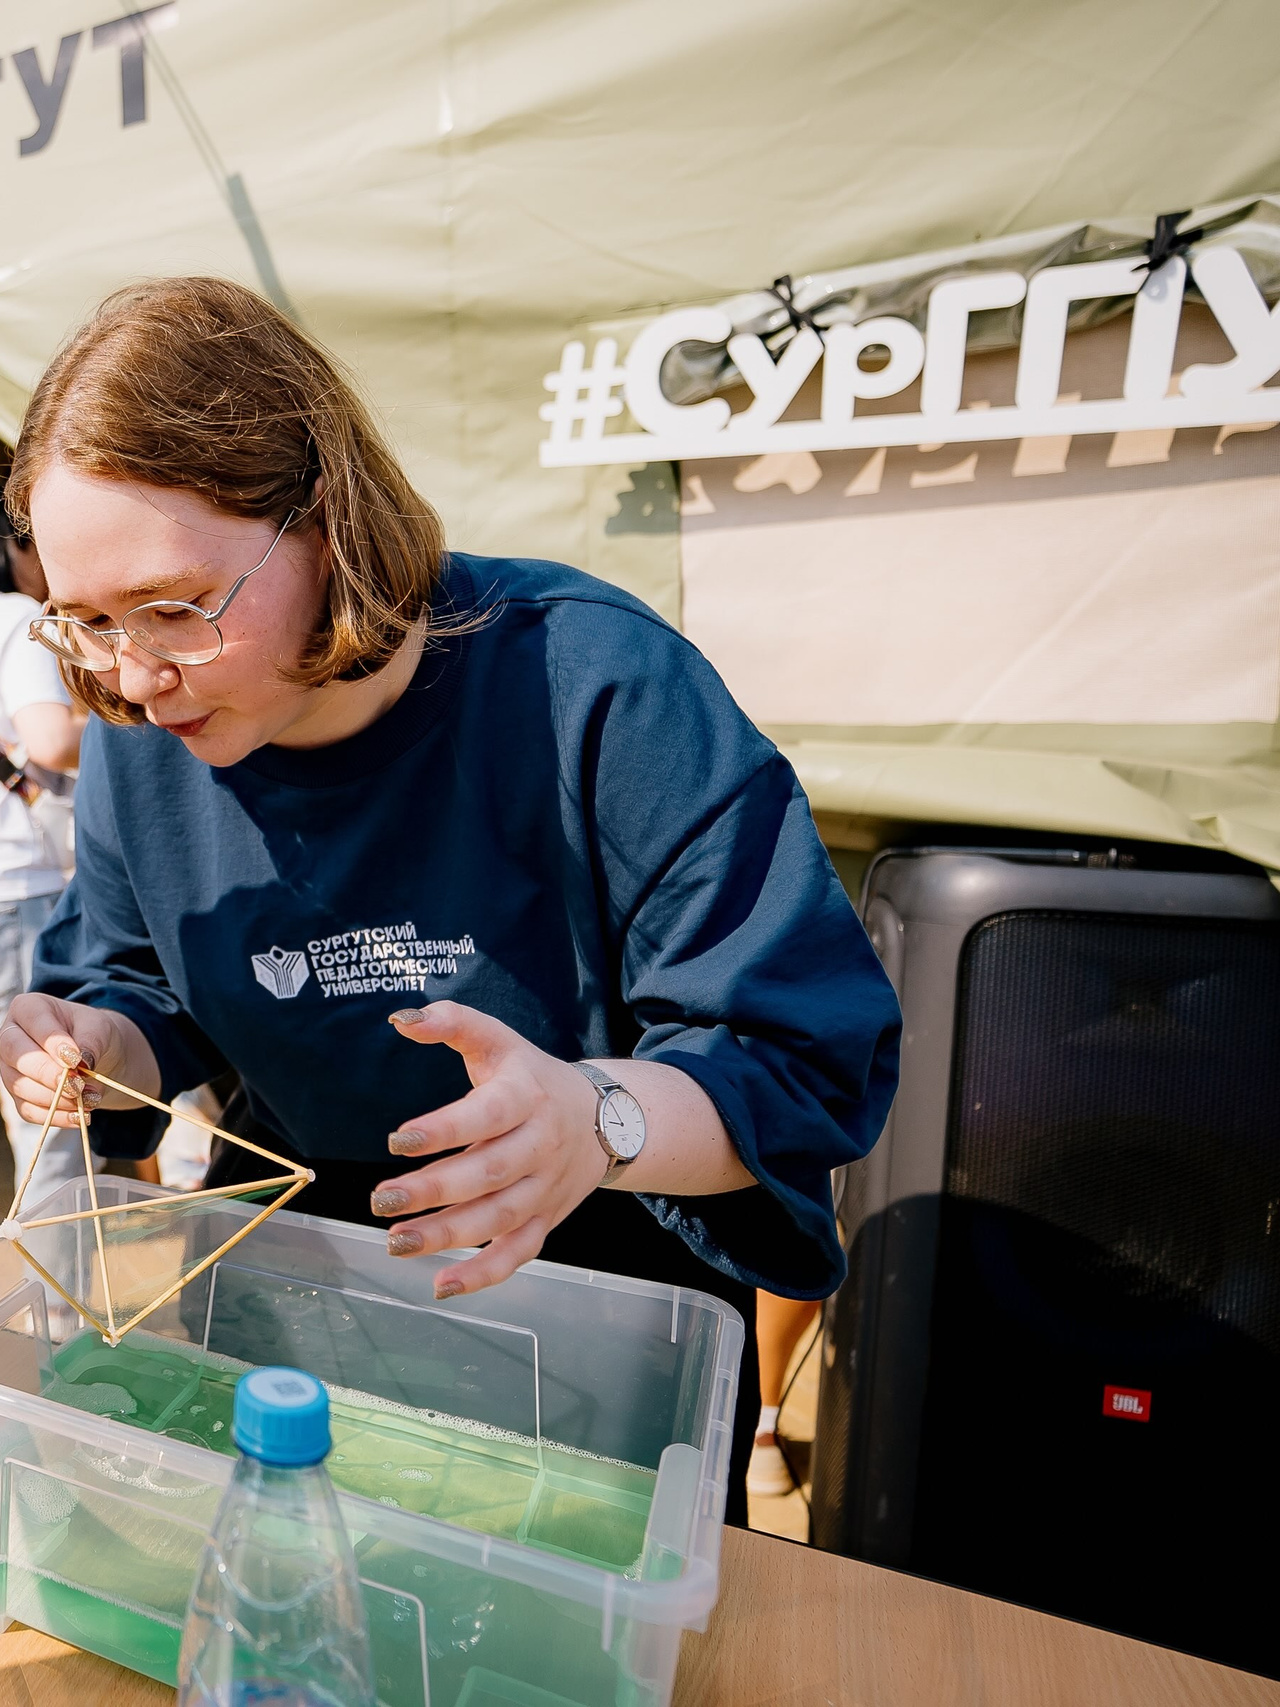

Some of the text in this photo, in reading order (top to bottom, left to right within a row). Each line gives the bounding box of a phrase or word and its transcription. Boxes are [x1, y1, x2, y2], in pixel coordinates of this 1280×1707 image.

[307, 921, 417, 955] СУРГУТСКИЙ
[311, 934, 475, 969] ГОСУДАРСТВЕННЫЙ
[316, 954, 457, 982] ПЕДАГОГИЧЕСКИЙ
[321, 976, 426, 998] УНИВЕРСИТЕТ
[1112, 1393, 1143, 1414] JBL
